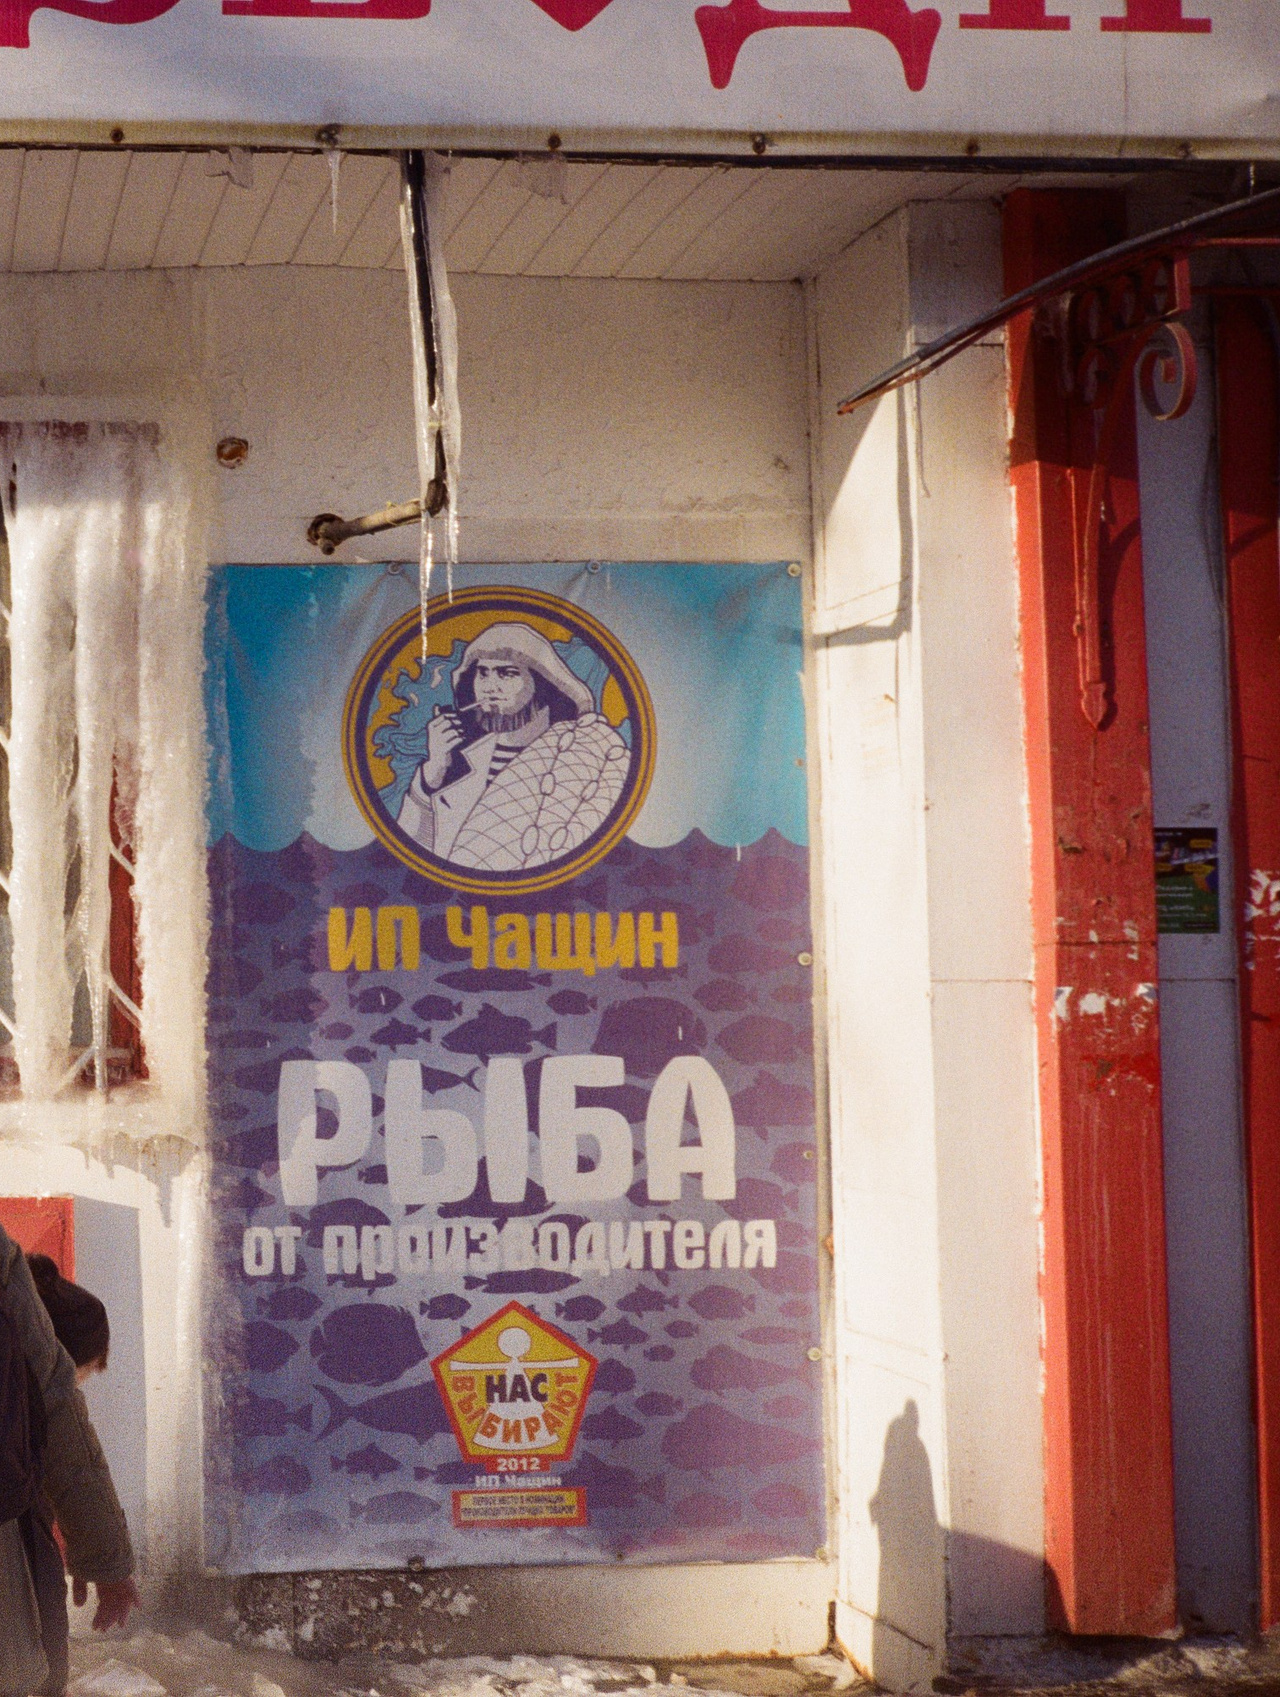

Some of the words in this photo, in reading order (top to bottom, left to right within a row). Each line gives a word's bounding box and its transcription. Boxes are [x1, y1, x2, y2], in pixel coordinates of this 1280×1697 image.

[328, 907, 420, 971] ИП
[447, 905, 679, 976] Чащин
[278, 1055, 736, 1206] РЫБА
[242, 1226, 302, 1276] от
[322, 1219, 777, 1280] производителя
[451, 1371, 581, 1444] ВЫБИРАЮТ
[485, 1372, 549, 1404] НАС
[474, 1475, 500, 1488] ИП
[496, 1457, 541, 1472] 2012
